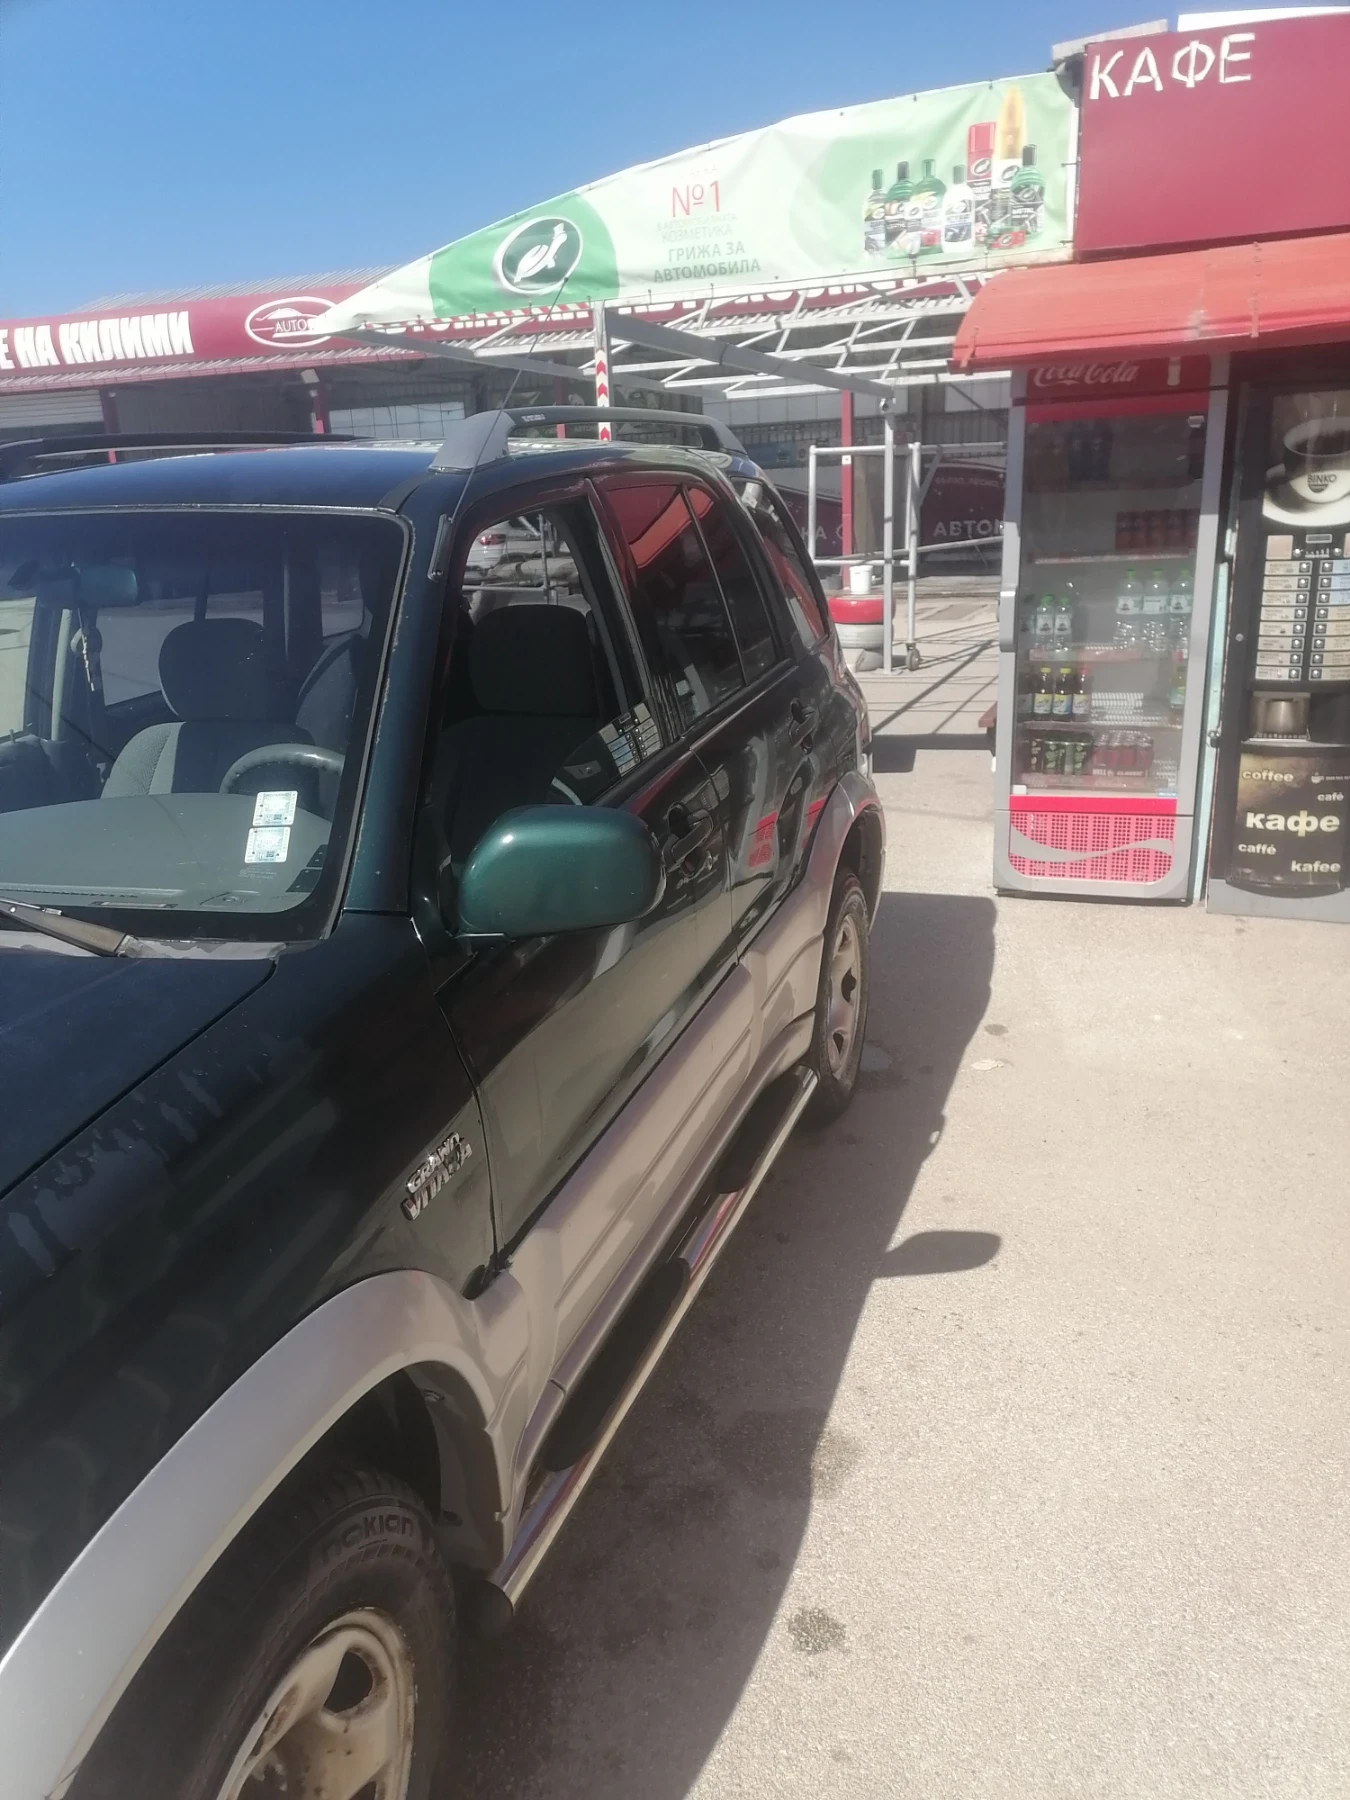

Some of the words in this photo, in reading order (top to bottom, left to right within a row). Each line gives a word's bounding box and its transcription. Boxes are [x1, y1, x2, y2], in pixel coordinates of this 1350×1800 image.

[1089, 32, 1256, 101] КАФЕ
[661, 224, 733, 243] КОЗМЕТИКА
[668, 243, 722, 262] ГРИЖА
[725, 240, 746, 256] ЗА
[653, 258, 761, 282] АВТОМОБИЛА
[14, 325, 60, 369] НА
[59, 311, 194, 365] КИЛИМИ
[1242, 770, 1294, 783] coffee
[1246, 810, 1340, 838] кафе
[1291, 860, 1342, 873] kafee
